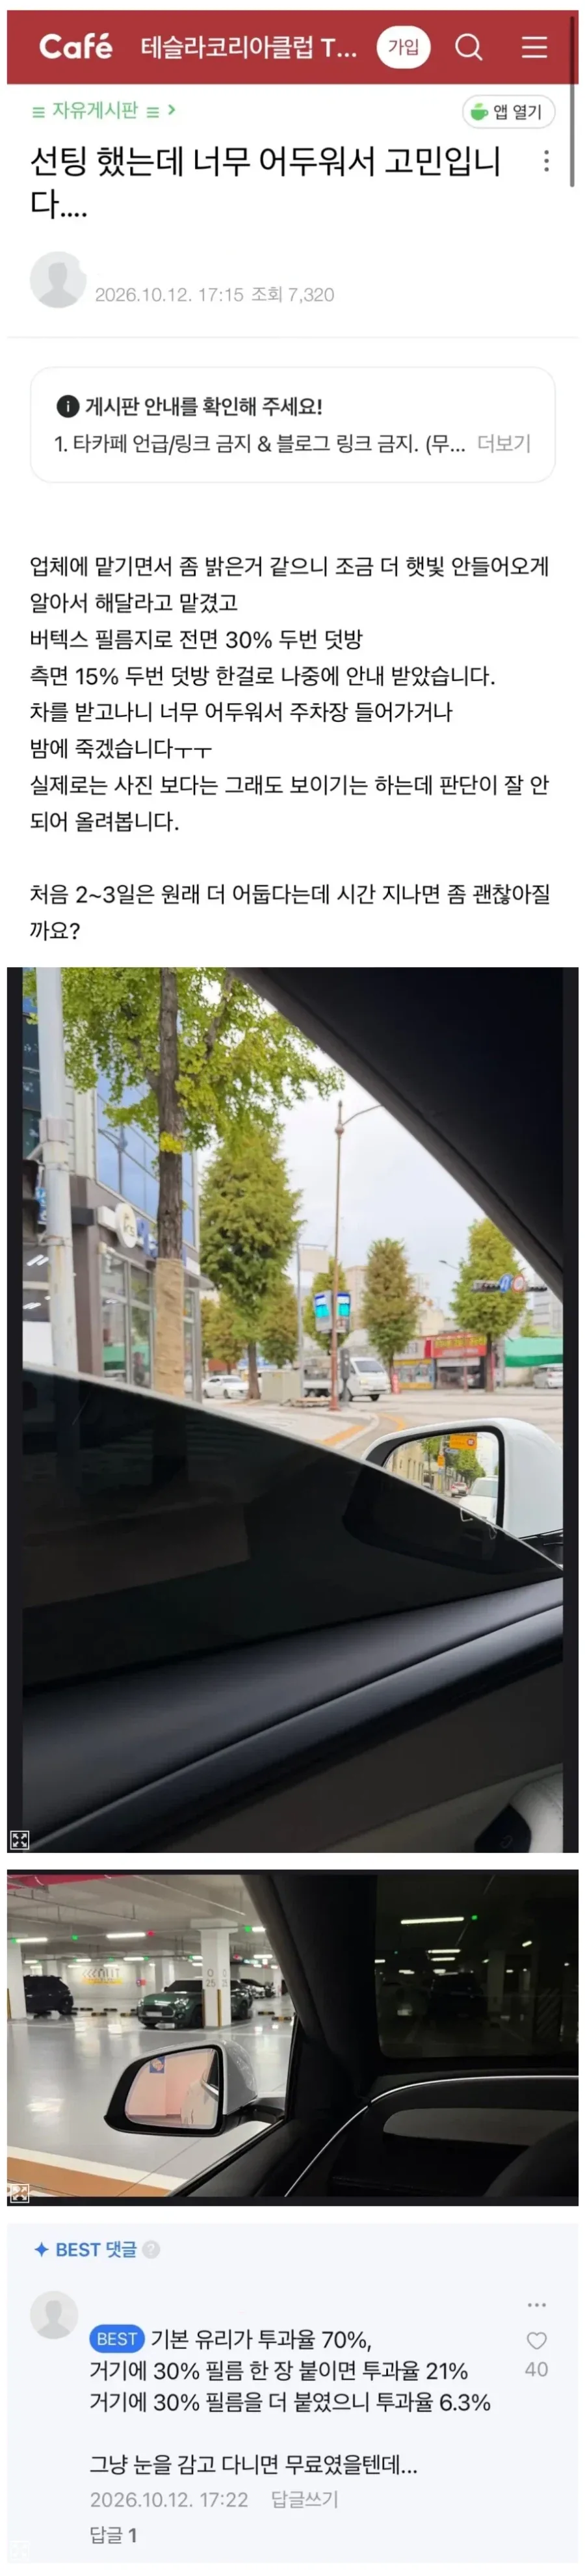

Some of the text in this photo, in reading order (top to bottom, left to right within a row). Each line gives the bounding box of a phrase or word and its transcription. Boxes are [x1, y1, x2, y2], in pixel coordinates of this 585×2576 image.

[39, 33, 113, 59] Café
[141, 35, 313, 60] 테슬라코리아클럽
[388, 38, 419, 56] 가입
[53, 101, 138, 120] 자유게시판
[493, 103, 541, 120] 앱 열기
[31, 146, 499, 178] 선팅 했는데 너무 어두워서 고민입니
[95, 285, 335, 304] 2026.10.12. 17:15 조회 7,320
[85, 396, 322, 417] 게시판 안내를 확인해 주세요!
[55, 436, 68, 452] 1.
[73, 433, 127, 454] 타카페
[133, 433, 211, 456] 언급/링크
[215, 434, 251, 454] 금지
[257, 435, 272, 453] &
[276, 434, 331, 453] 블로그
[337, 433, 372, 453] 링크
[377, 433, 419, 454] 금지.
[478, 434, 530, 454] 더보기
[30, 555, 549, 578] 업체에 맡기면서 좀 밝은거 같으니 조금 더 햇빛 안들어오게
[30, 592, 238, 614] 알아서 해달라고 맡겼고
[31, 628, 363, 650] 버텍스 필름지로 전면 30% 두번 덧방
[30, 665, 495, 687] 측면 15% 두번 덧방 한걸로 나중에 안내 받았습니다.
[30, 701, 454, 723] 차를 받고나니 너무 어두워서 주차장 들어가거나
[31, 737, 68, 760] 밤에
[30, 774, 550, 796] 실제로는 사진 보다는 그래도 보이기는 하는데 판단이 잘 안
[30, 811, 179, 832] 되어 올려봅니다.
[30, 883, 550, 905] 처음 2~3일은 원래 더 어둡다는데 시간 지나면 좀 괜찮아질
[29, 920, 81, 942] 까요?
[206, 1979, 216, 1987] 25
[56, 2240, 138, 2259] BEST 댓글
[96, 2331, 138, 2346] BEST
[151, 2328, 372, 2353] 기본 유리가 투과율 70%,
[90, 2359, 469, 2382] 거기에 30% 필름 한 장 붙이면 투과율 21%
[525, 2361, 549, 2378] 40
[90, 2391, 491, 2413] 거기에 30% 필름을 더 붙였으니 투과율 6.3%
[90, 2454, 128, 2475] 그냥
[133, 2454, 172, 2475] 눈을
[177, 2454, 216, 2475] 감고
[222, 2454, 278, 2476] 다니면
[90, 2491, 248, 2508] 2026.10.12. 17:22
[272, 2490, 338, 2509] 답글쓰기
[90, 2525, 136, 2544] 답글 1
